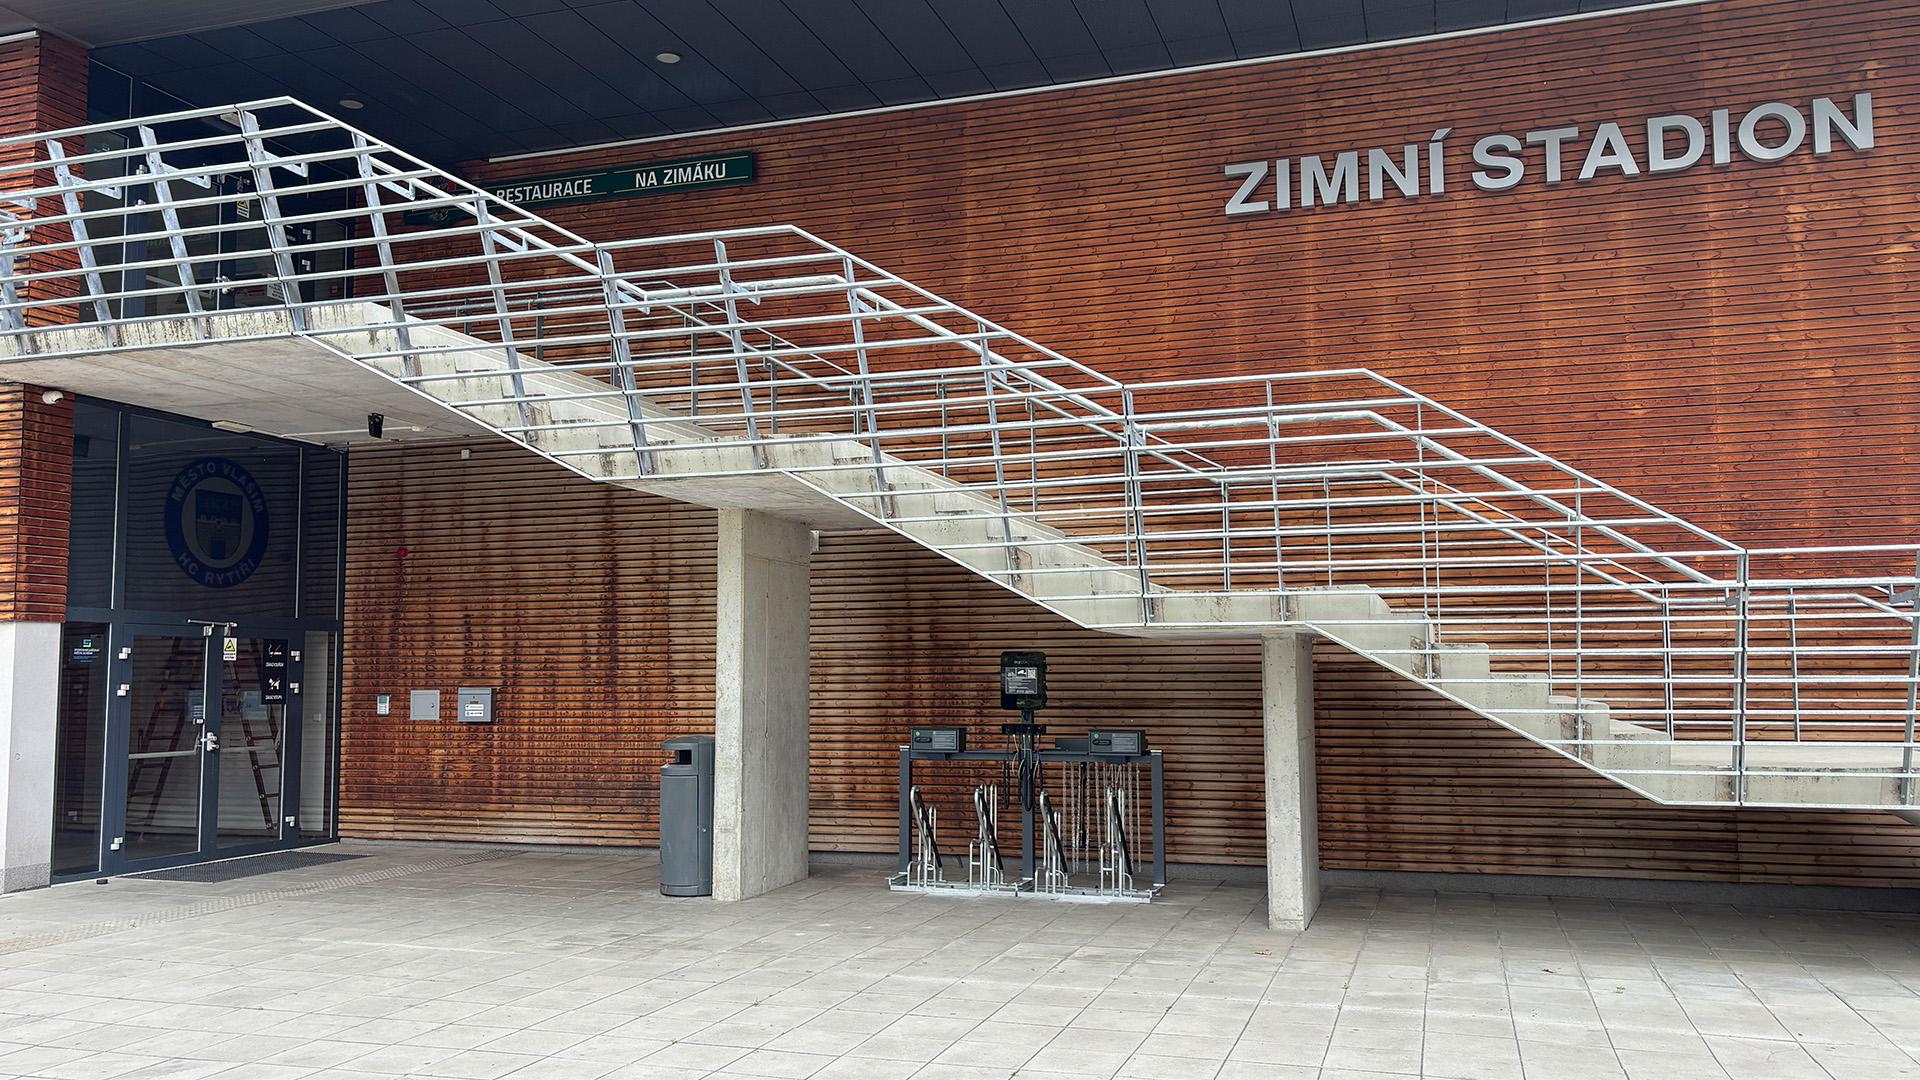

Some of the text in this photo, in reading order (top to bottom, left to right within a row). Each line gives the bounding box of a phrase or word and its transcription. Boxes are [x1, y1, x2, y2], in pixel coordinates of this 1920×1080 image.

[1225, 93, 1875, 217] ZIMNÍ STADION
[496, 162, 726, 204] RESTAURACE NA ZIMÁKU
[171, 461, 217, 502] MĚSTO
[178, 552, 199, 575] HC
